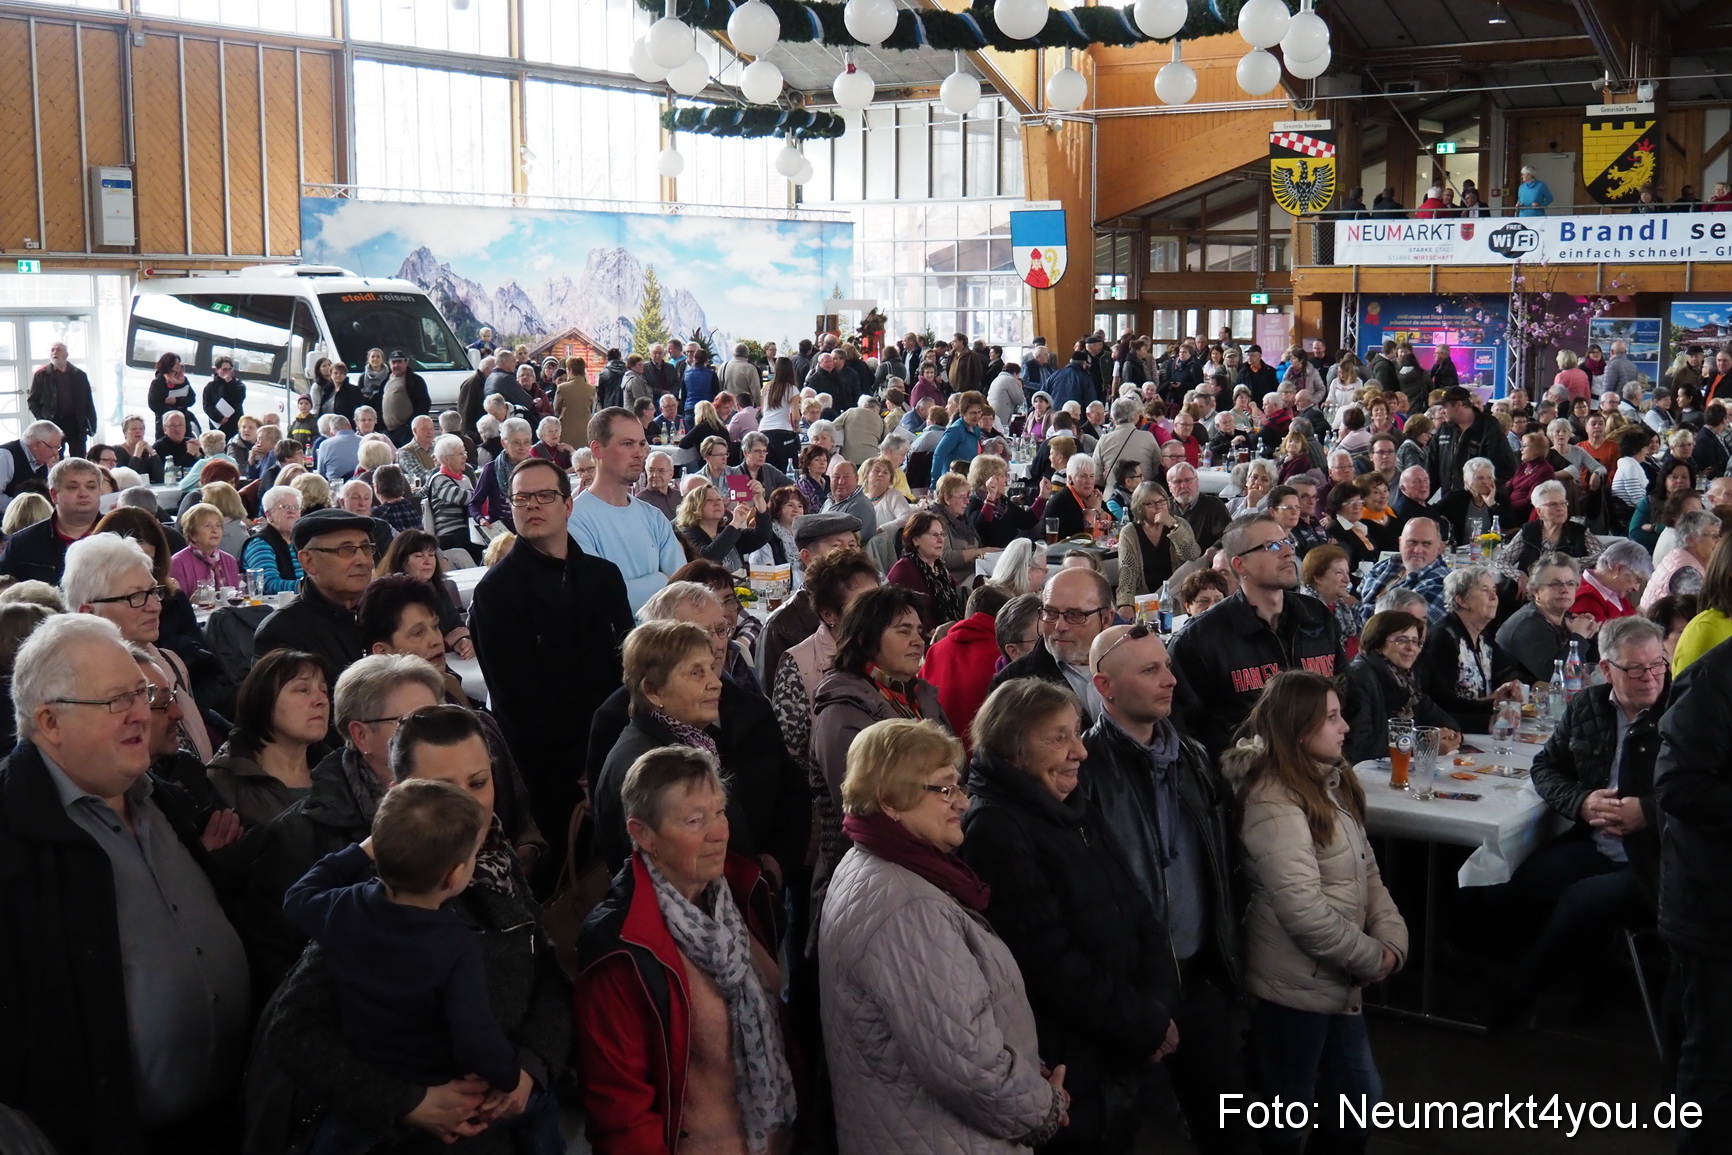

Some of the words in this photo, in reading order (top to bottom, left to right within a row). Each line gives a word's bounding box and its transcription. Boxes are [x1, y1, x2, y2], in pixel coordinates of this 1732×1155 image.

[1347, 223, 1455, 241] NEUMARKT
[1560, 219, 1668, 242] Brandl
[1690, 222, 1726, 240] se
[1559, 248, 1621, 259] einfach
[1628, 246, 1692, 258] schnell
[341, 292, 416, 303] steidl.reisen
[1230, 663, 1280, 693] HARLEY
